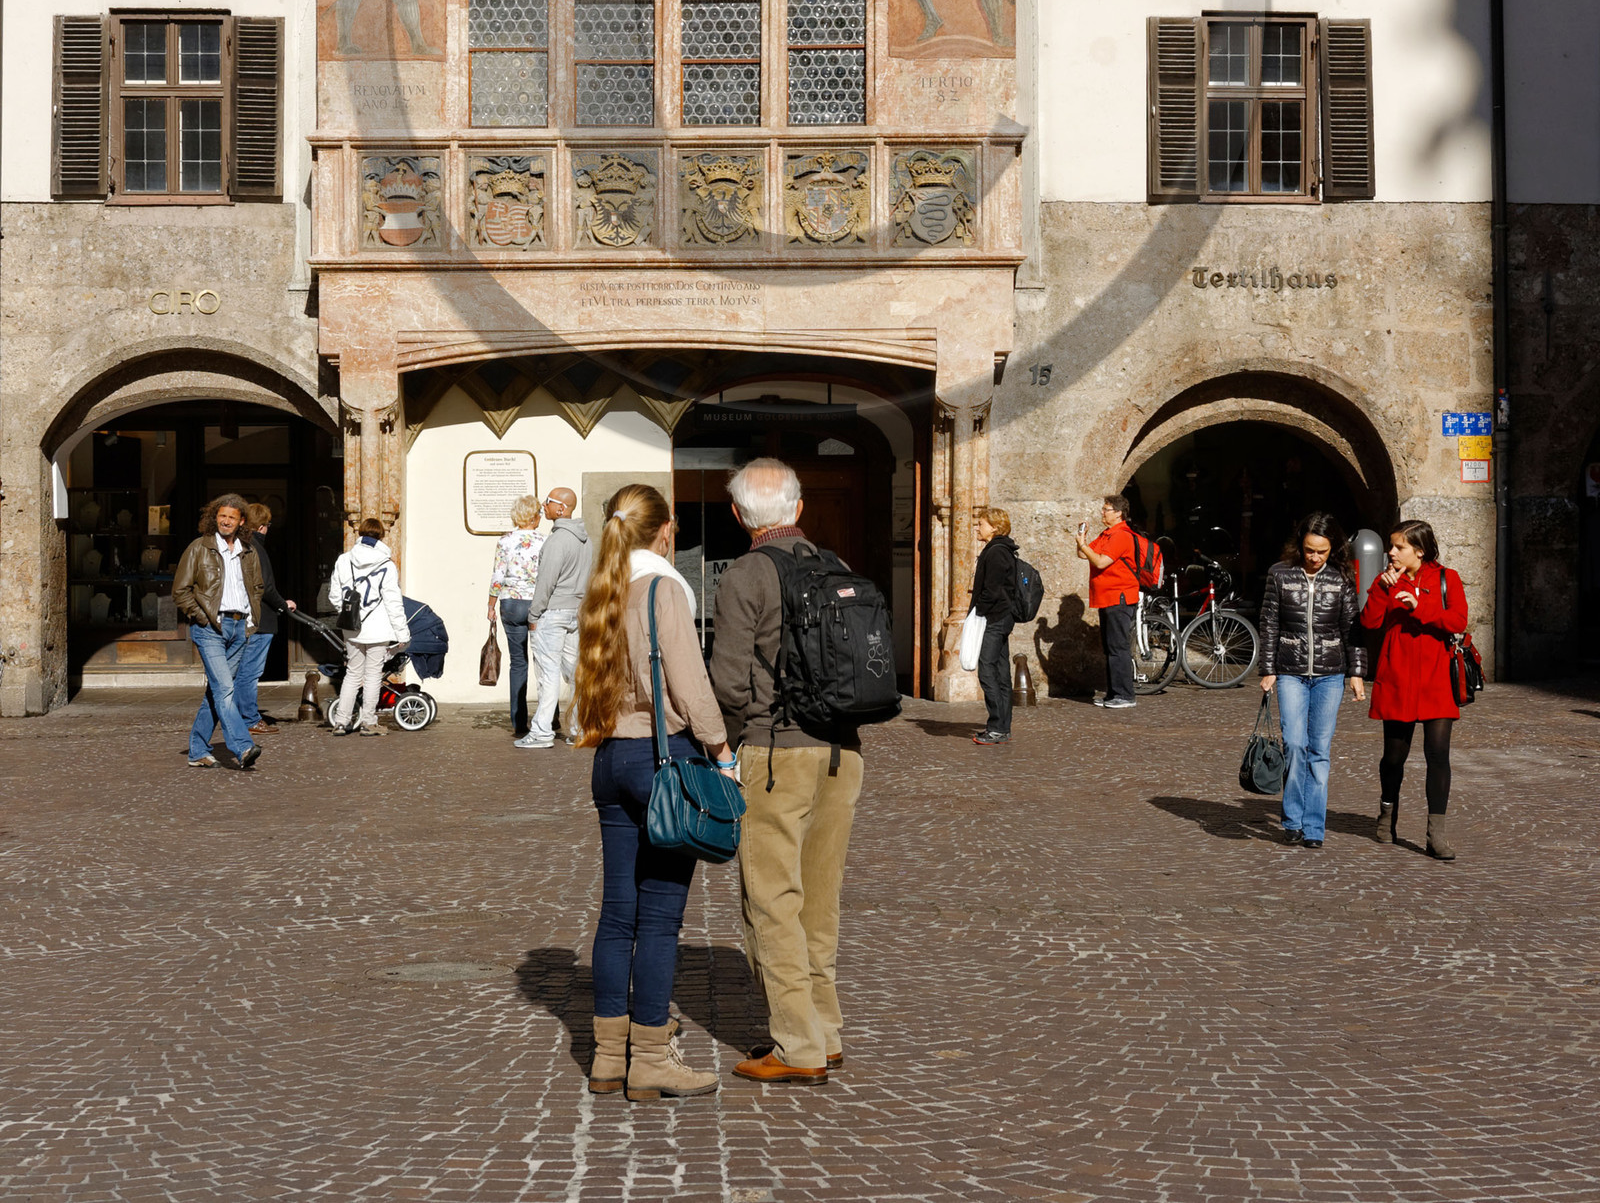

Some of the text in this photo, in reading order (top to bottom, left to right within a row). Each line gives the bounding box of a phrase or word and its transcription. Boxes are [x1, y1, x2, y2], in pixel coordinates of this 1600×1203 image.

[921, 77, 973, 88] TERTIO
[1191, 266, 1339, 294] Textilhaus
[1029, 363, 1053, 385] 15
[703, 413, 753, 422] MUSEUM
